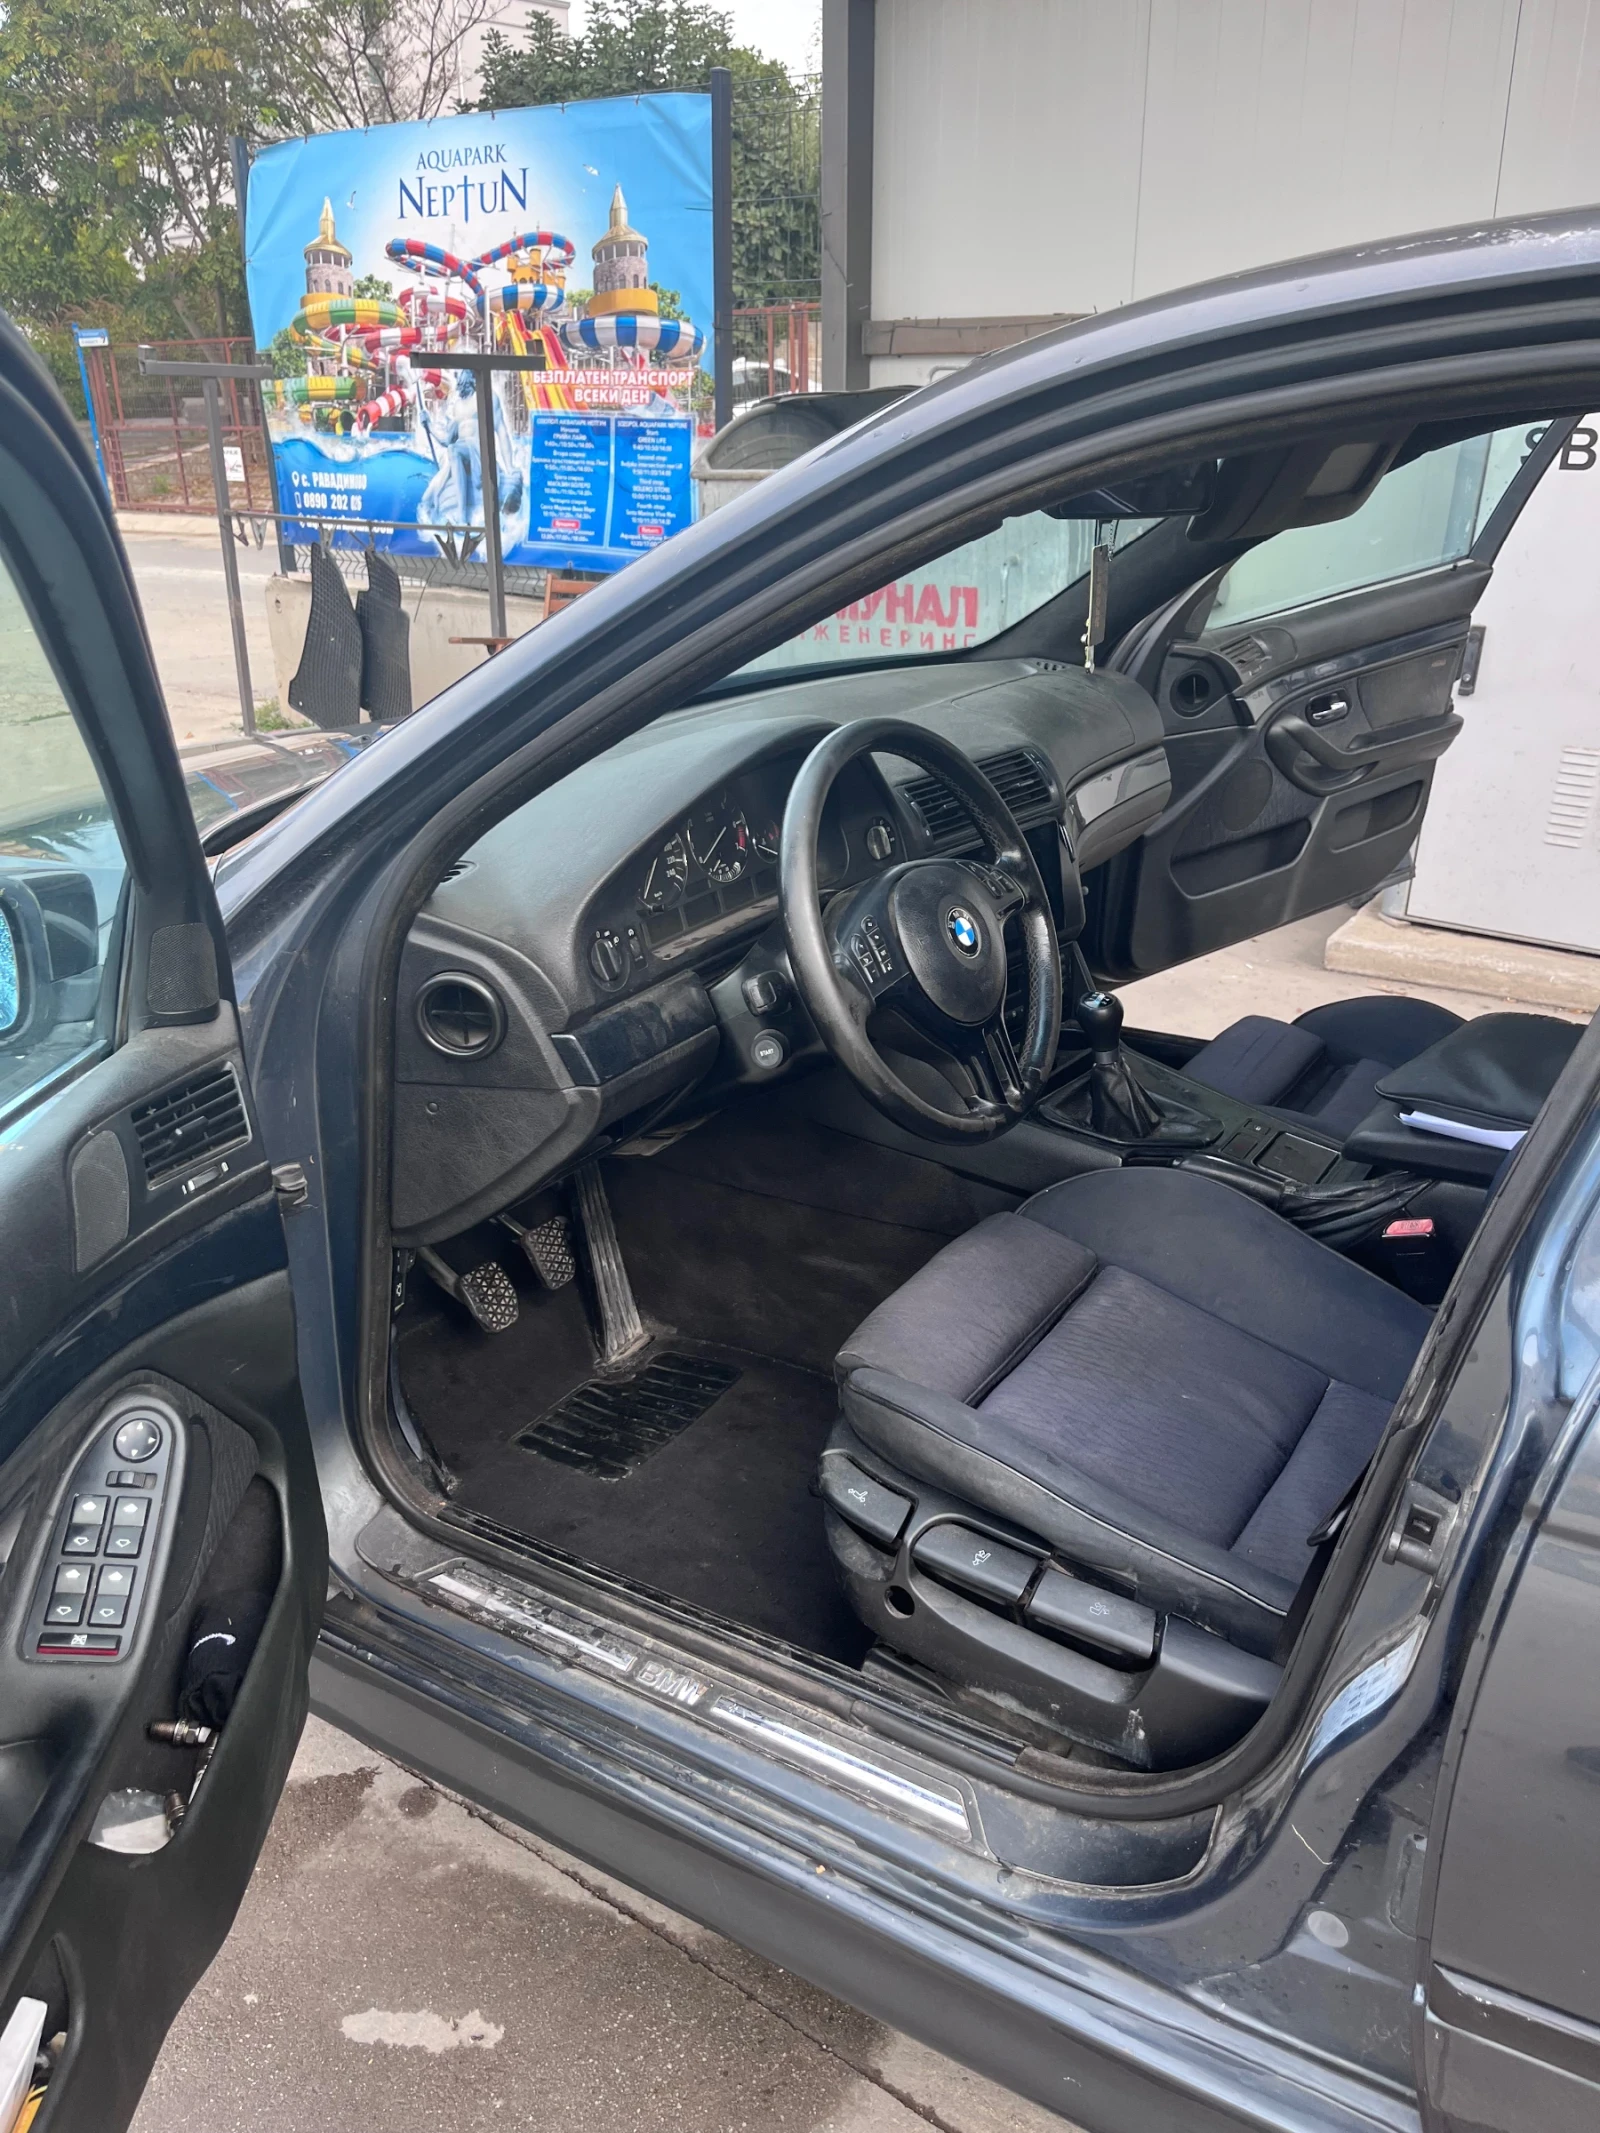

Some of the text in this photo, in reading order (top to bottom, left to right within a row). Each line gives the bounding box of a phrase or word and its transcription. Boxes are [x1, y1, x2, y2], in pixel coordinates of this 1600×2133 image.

[416, 144, 507, 172] AQUAPARK
[397, 167, 529, 224] NEPTUN
[533, 370, 694, 386] БЕЗПЛАТЕН ТРАНСПОРТ
[574, 388, 650, 405] ВСЕКИ ДЕН
[303, 491, 328, 509] 0890
[330, 493, 349, 510] 202
[635, 1660, 708, 1706] BMW
